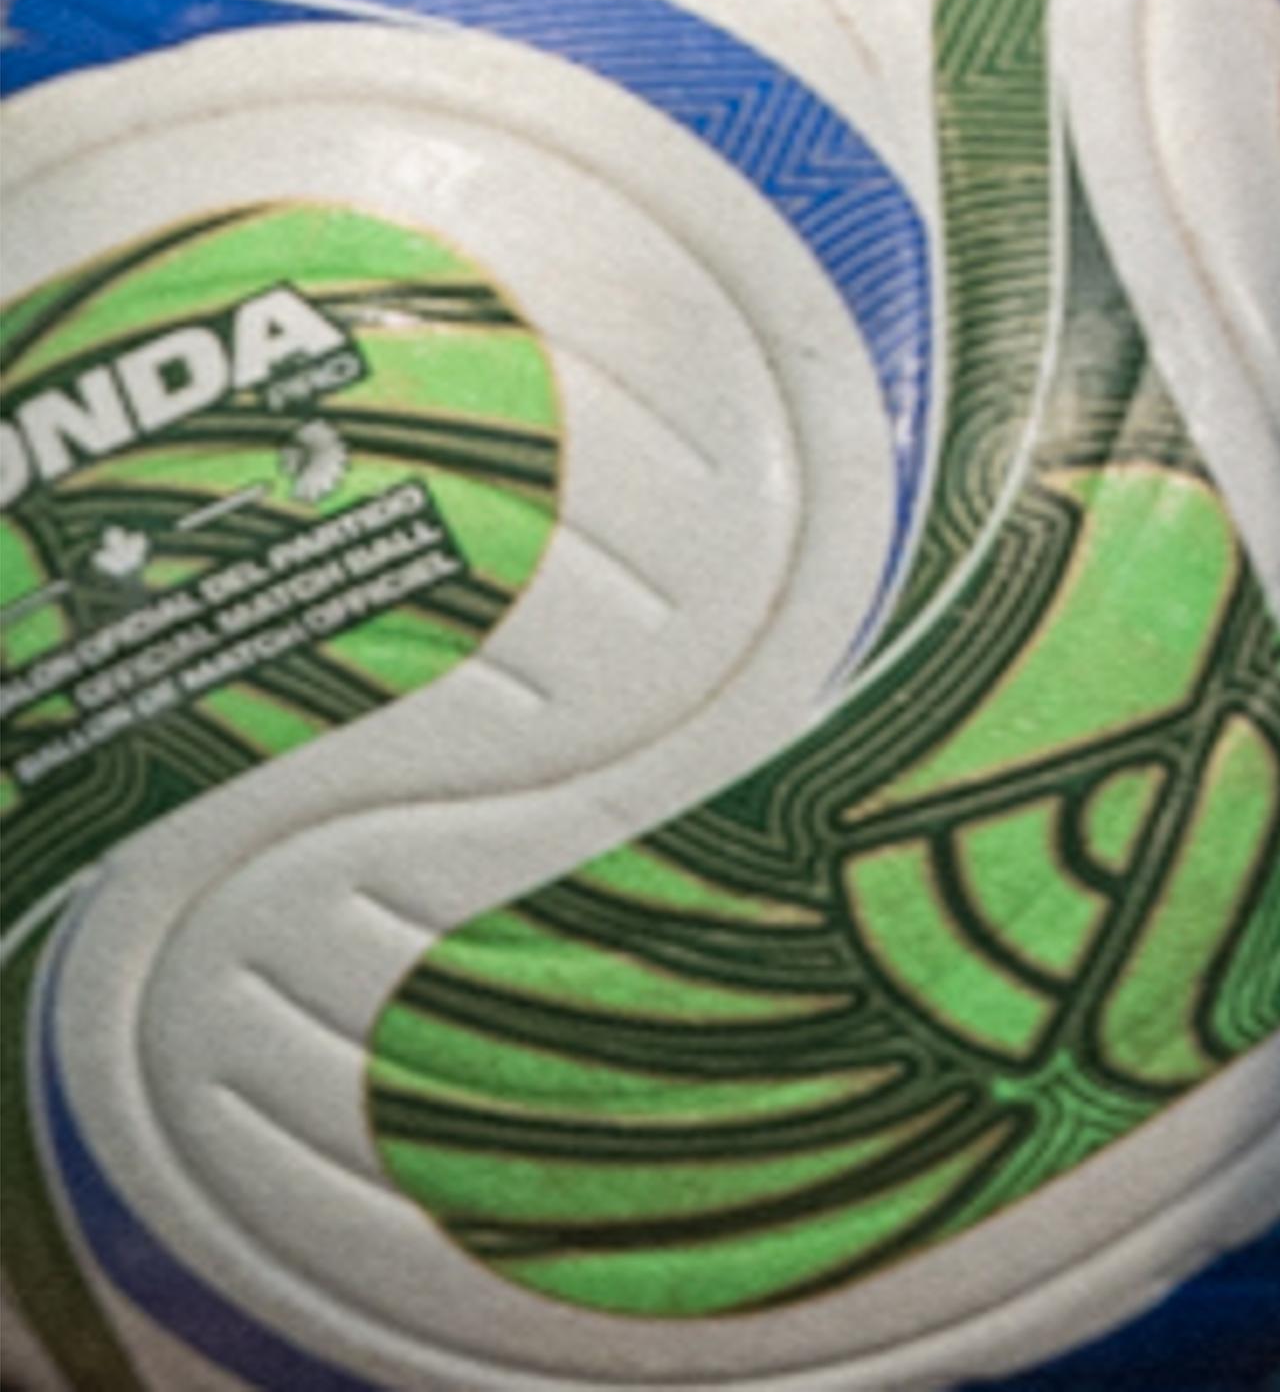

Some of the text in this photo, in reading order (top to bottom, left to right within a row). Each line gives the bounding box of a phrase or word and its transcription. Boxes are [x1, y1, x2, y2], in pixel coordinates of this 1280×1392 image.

[0, 287, 347, 508] NDA
[73, 520, 443, 709] OFFICIAL MATCH BALL
[199, 561, 270, 603] DEL
[267, 483, 426, 571] PARTIDO
[180, 618, 309, 693] MATCH
